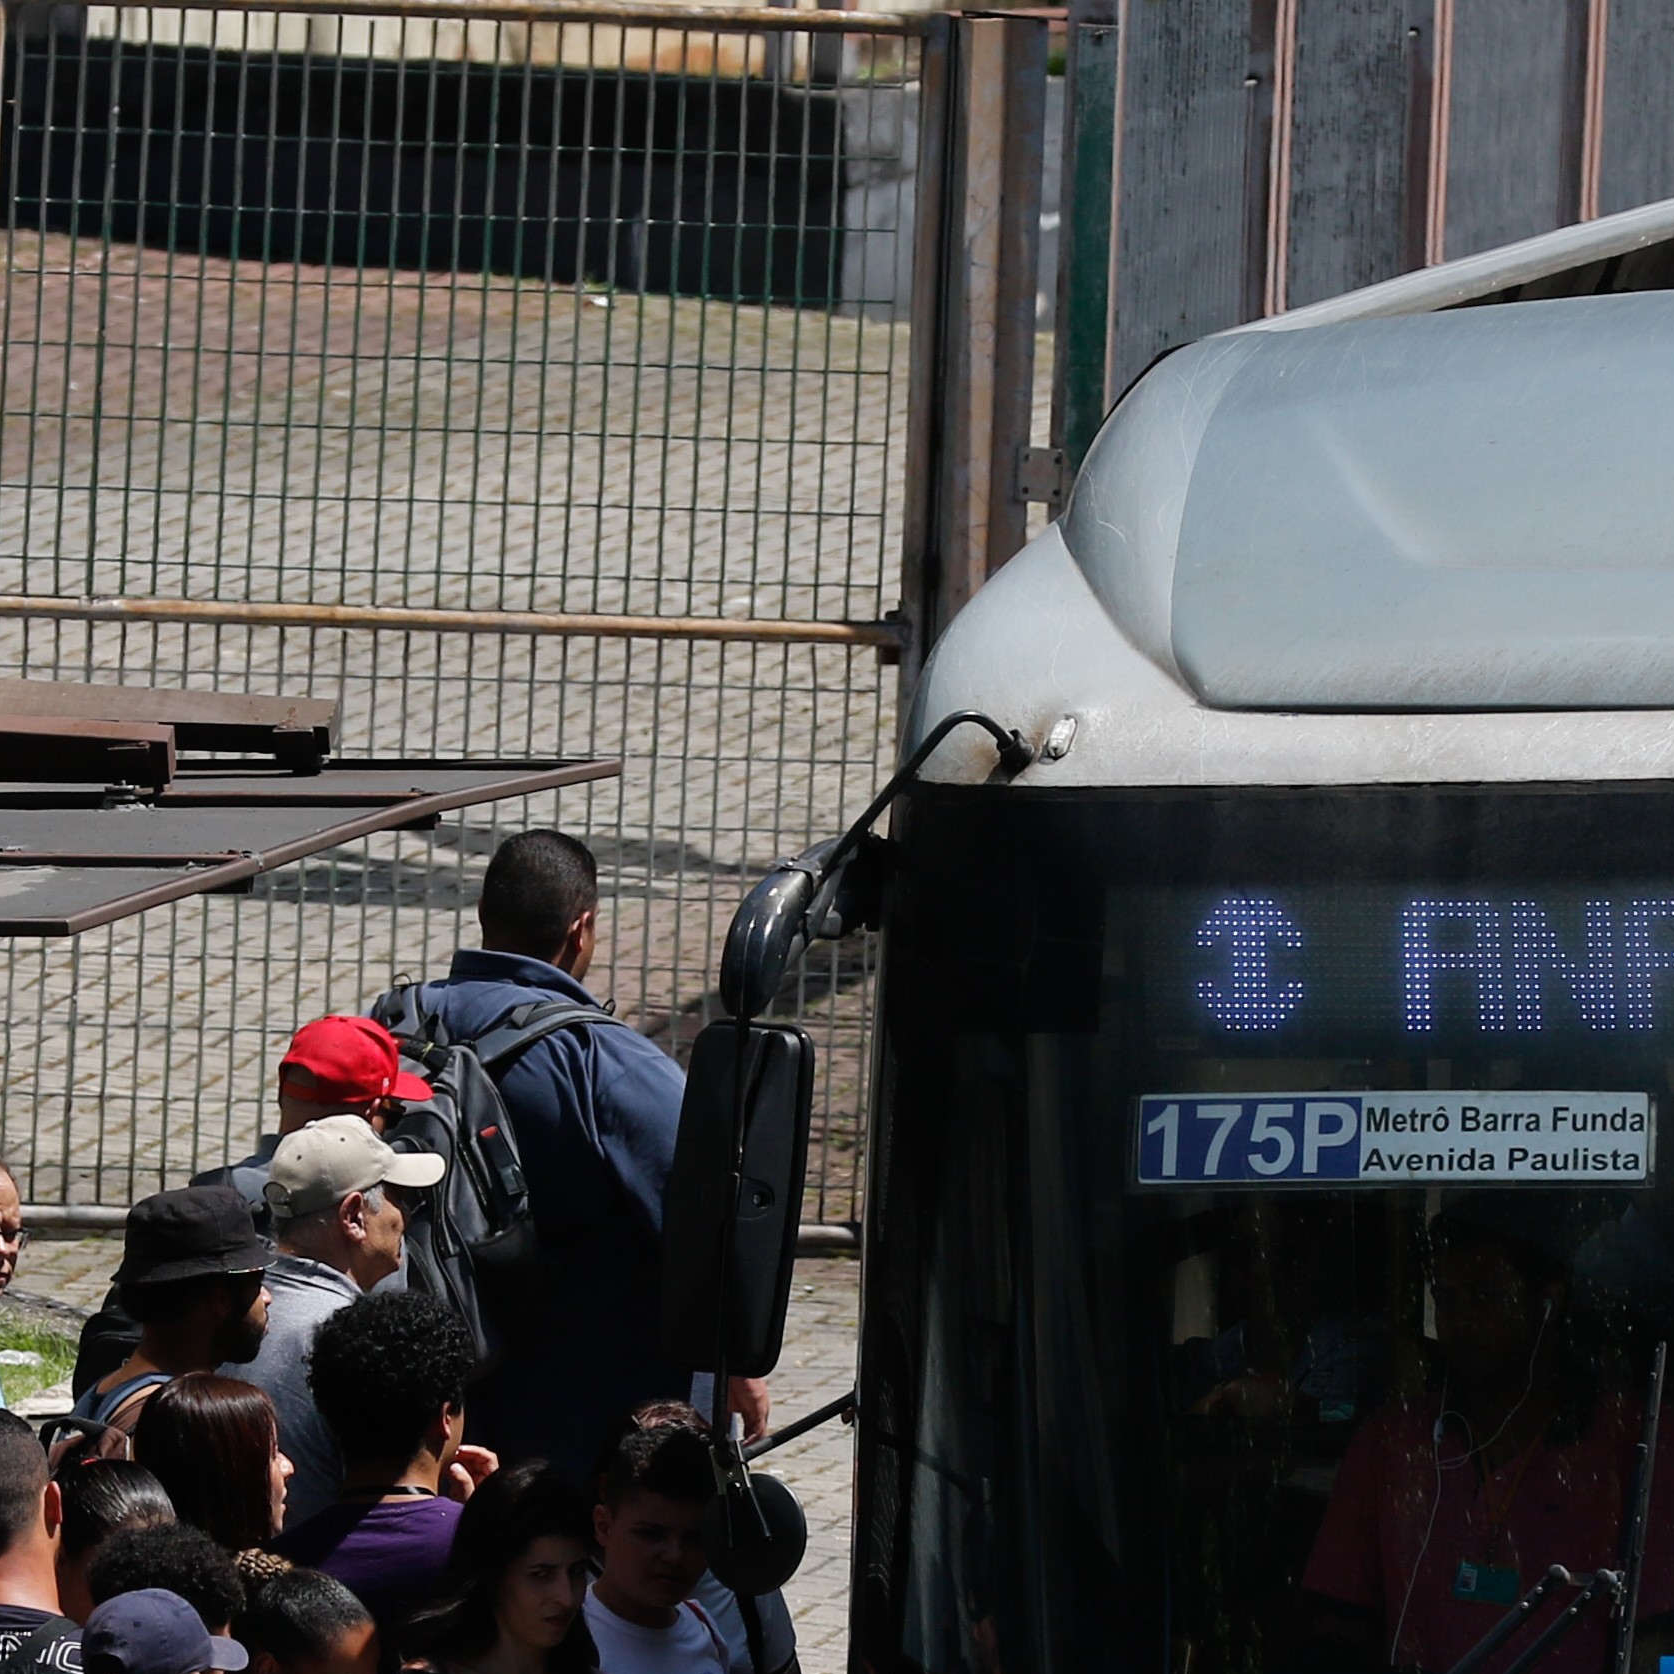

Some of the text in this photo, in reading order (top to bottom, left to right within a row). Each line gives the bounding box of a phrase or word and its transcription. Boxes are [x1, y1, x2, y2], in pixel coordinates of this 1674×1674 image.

[1364, 1101, 1647, 1137] Metrô Barra Funda
[1143, 1100, 1358, 1178] 175P
[1361, 1144, 1643, 1175] Avenida Paulista
